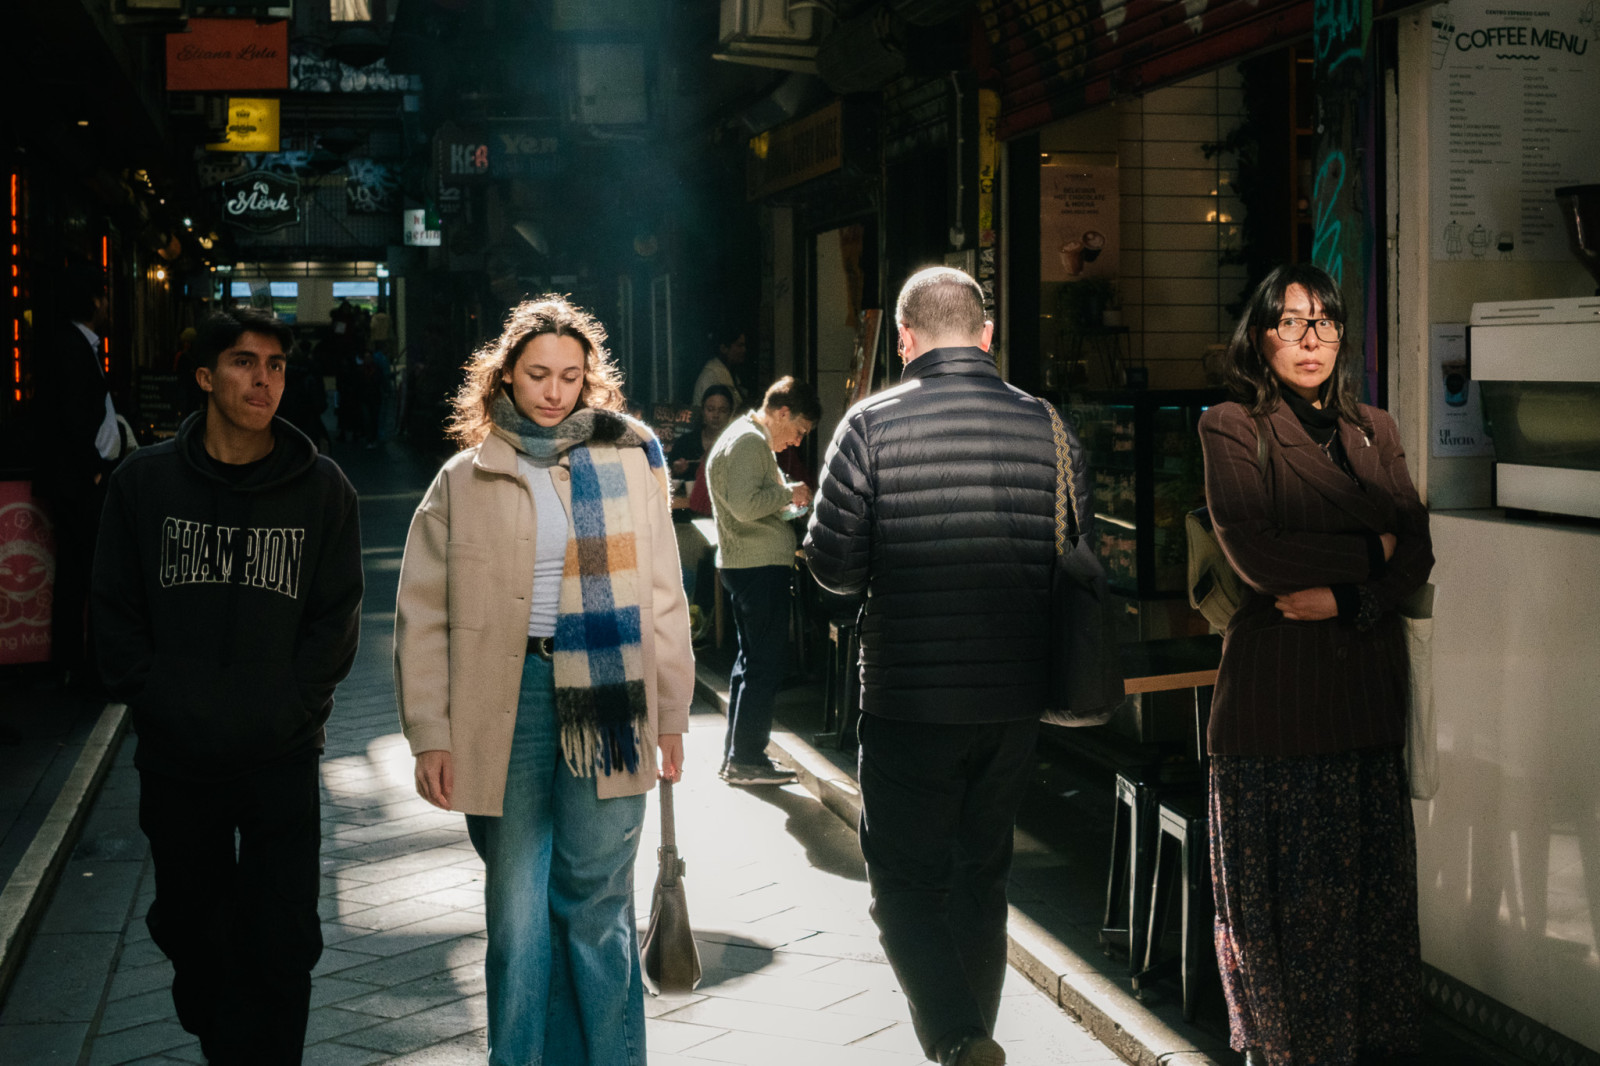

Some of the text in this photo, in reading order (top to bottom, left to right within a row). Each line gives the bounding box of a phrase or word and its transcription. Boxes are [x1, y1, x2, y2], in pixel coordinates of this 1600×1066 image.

[235, 43, 278, 61] Lulu
[1455, 26, 1588, 55] COFFEE MENU
[1439, 437, 1476, 446] MATCHA
[160, 516, 305, 599] CHAMPION
